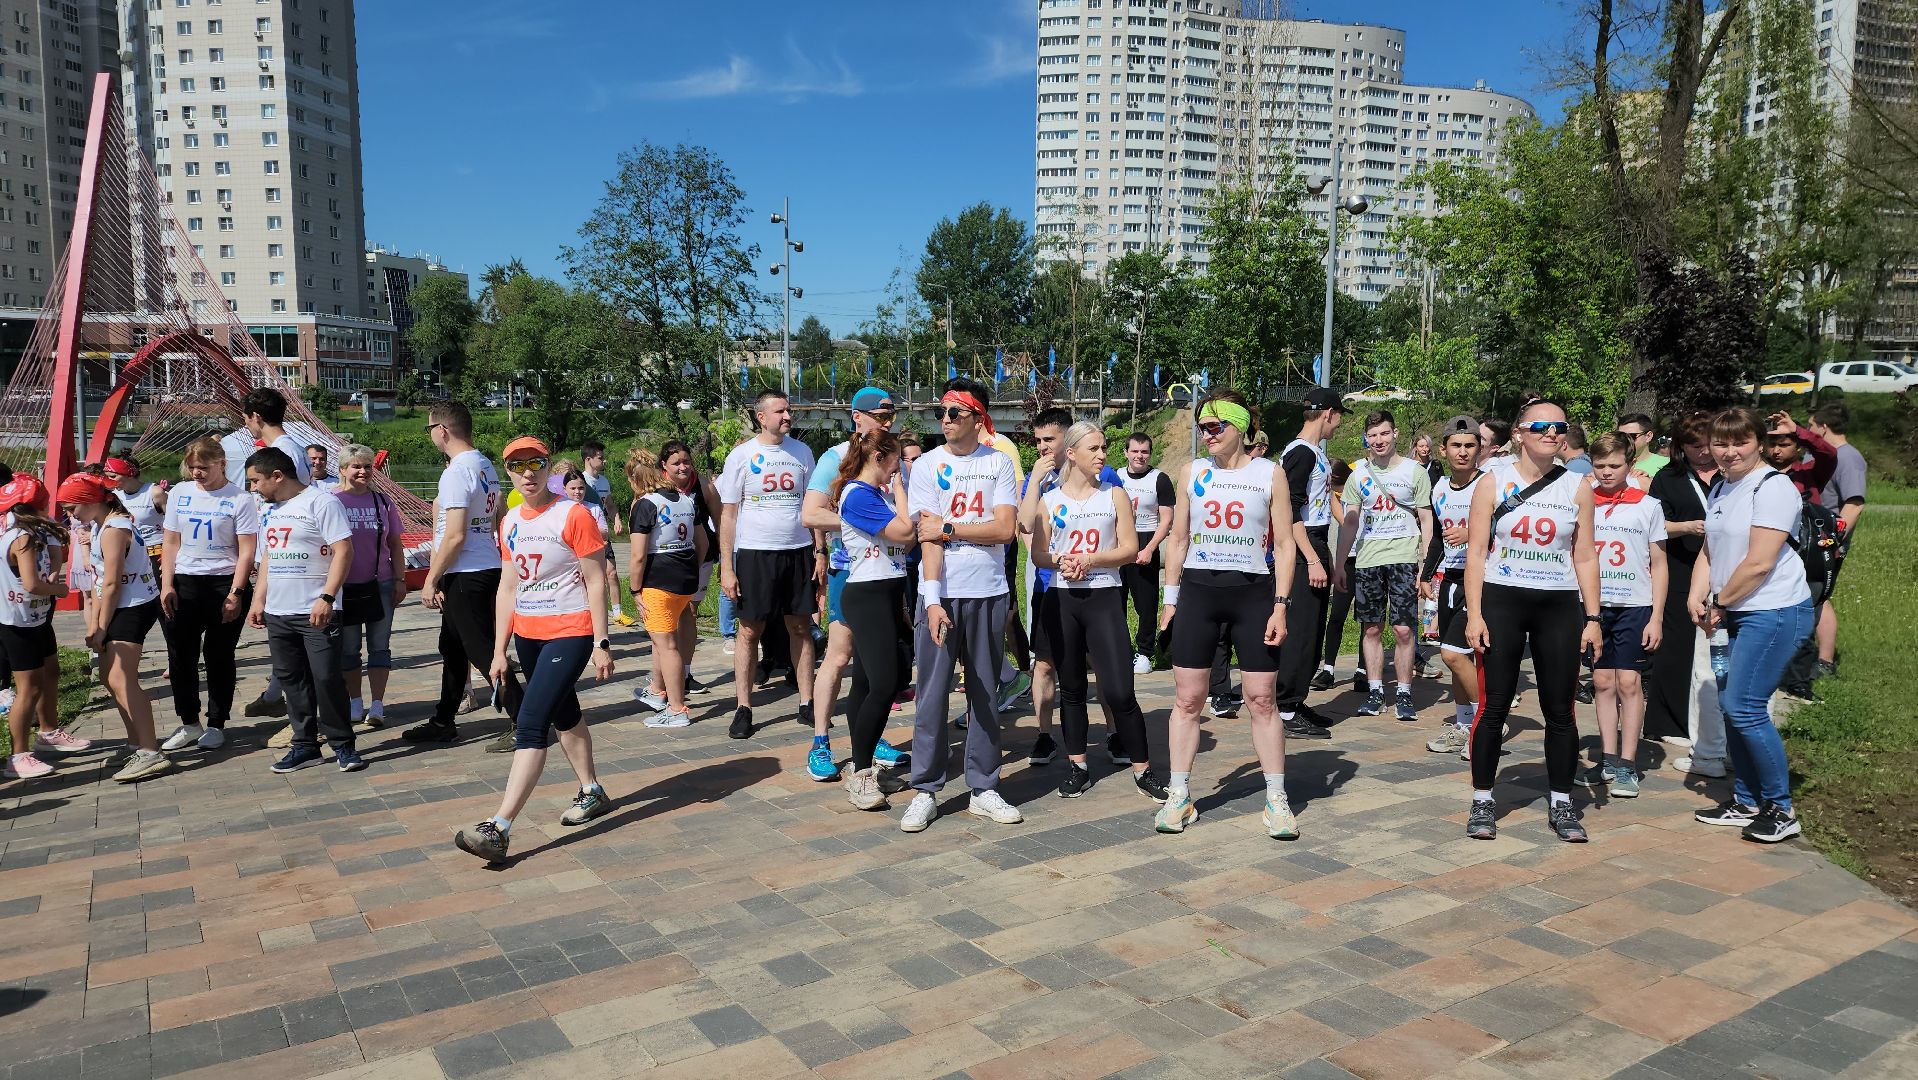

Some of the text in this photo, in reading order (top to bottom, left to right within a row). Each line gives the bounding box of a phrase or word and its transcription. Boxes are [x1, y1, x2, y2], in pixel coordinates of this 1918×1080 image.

[762, 471, 795, 492] 56
[1211, 481, 1265, 493] Ростелеком
[951, 490, 985, 518] 64
[1372, 494, 1397, 511] 40
[1203, 500, 1245, 529] 36
[189, 518, 212, 540] 71
[266, 528, 293, 549] 67
[678, 522, 688, 541] 9
[1510, 515, 1557, 546] 49
[1596, 524, 1643, 535] Ростелеком
[1069, 528, 1100, 555] 29
[1202, 534, 1255, 546] ПУШКИНО
[1509, 548, 1565, 563] ПУШКИНО
[1594, 541, 1626, 567] 73
[515, 553, 543, 580] 37
[8, 591, 24, 604] 95
